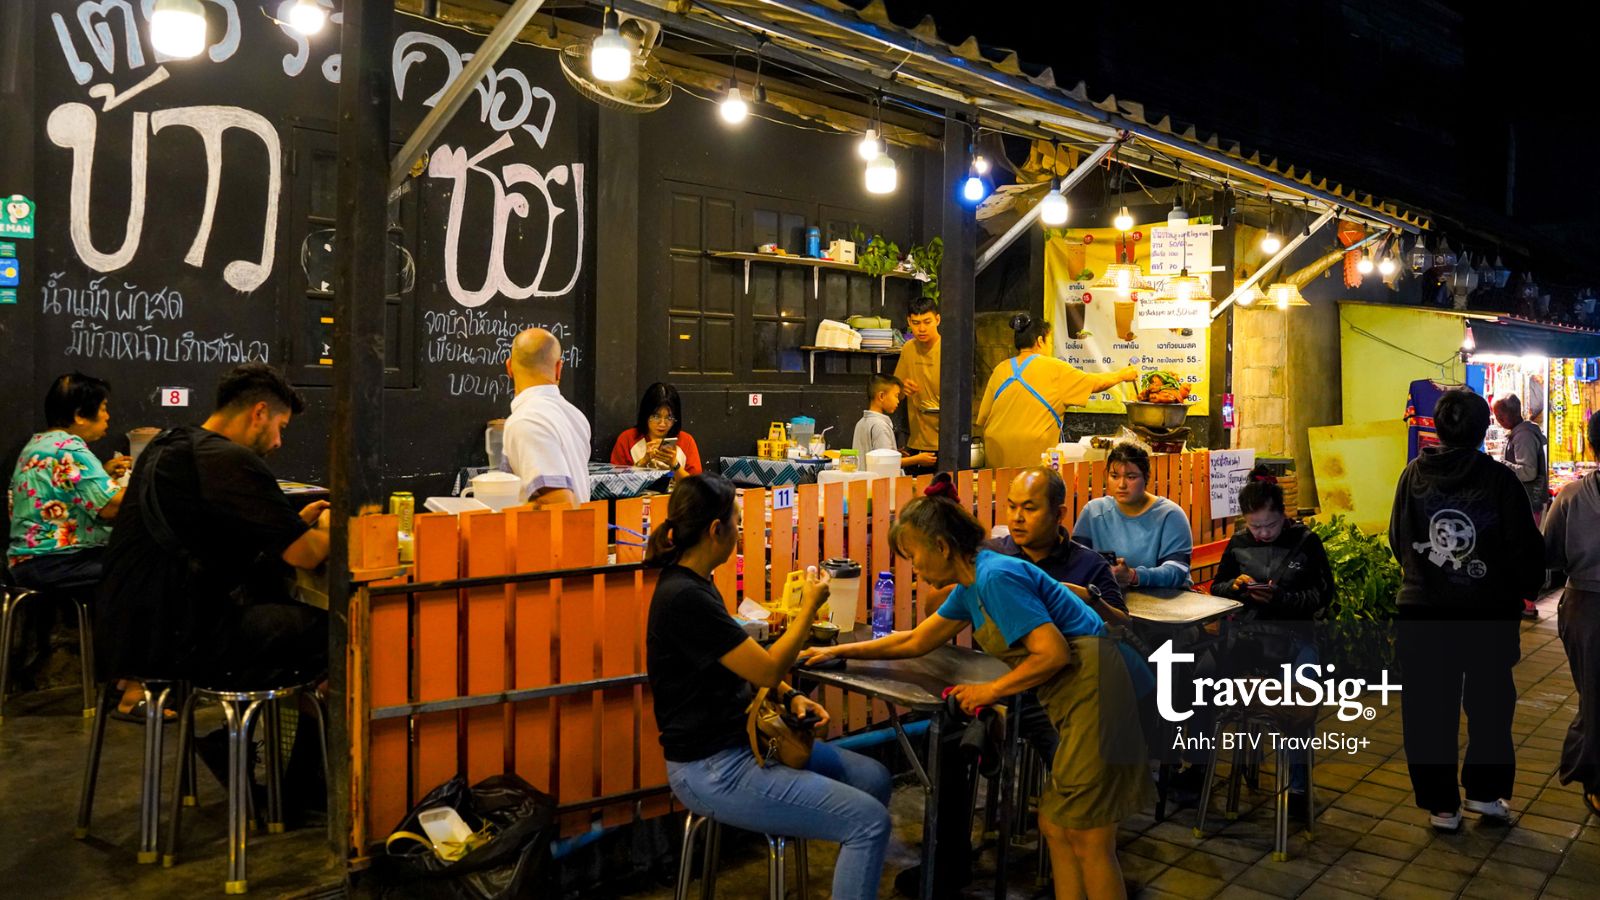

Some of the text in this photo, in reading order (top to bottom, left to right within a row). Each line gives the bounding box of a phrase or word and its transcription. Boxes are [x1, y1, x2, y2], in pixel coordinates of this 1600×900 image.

[169, 389, 181, 405] 8
[752, 394, 759, 405] 6
[778, 489, 790, 506] 11
